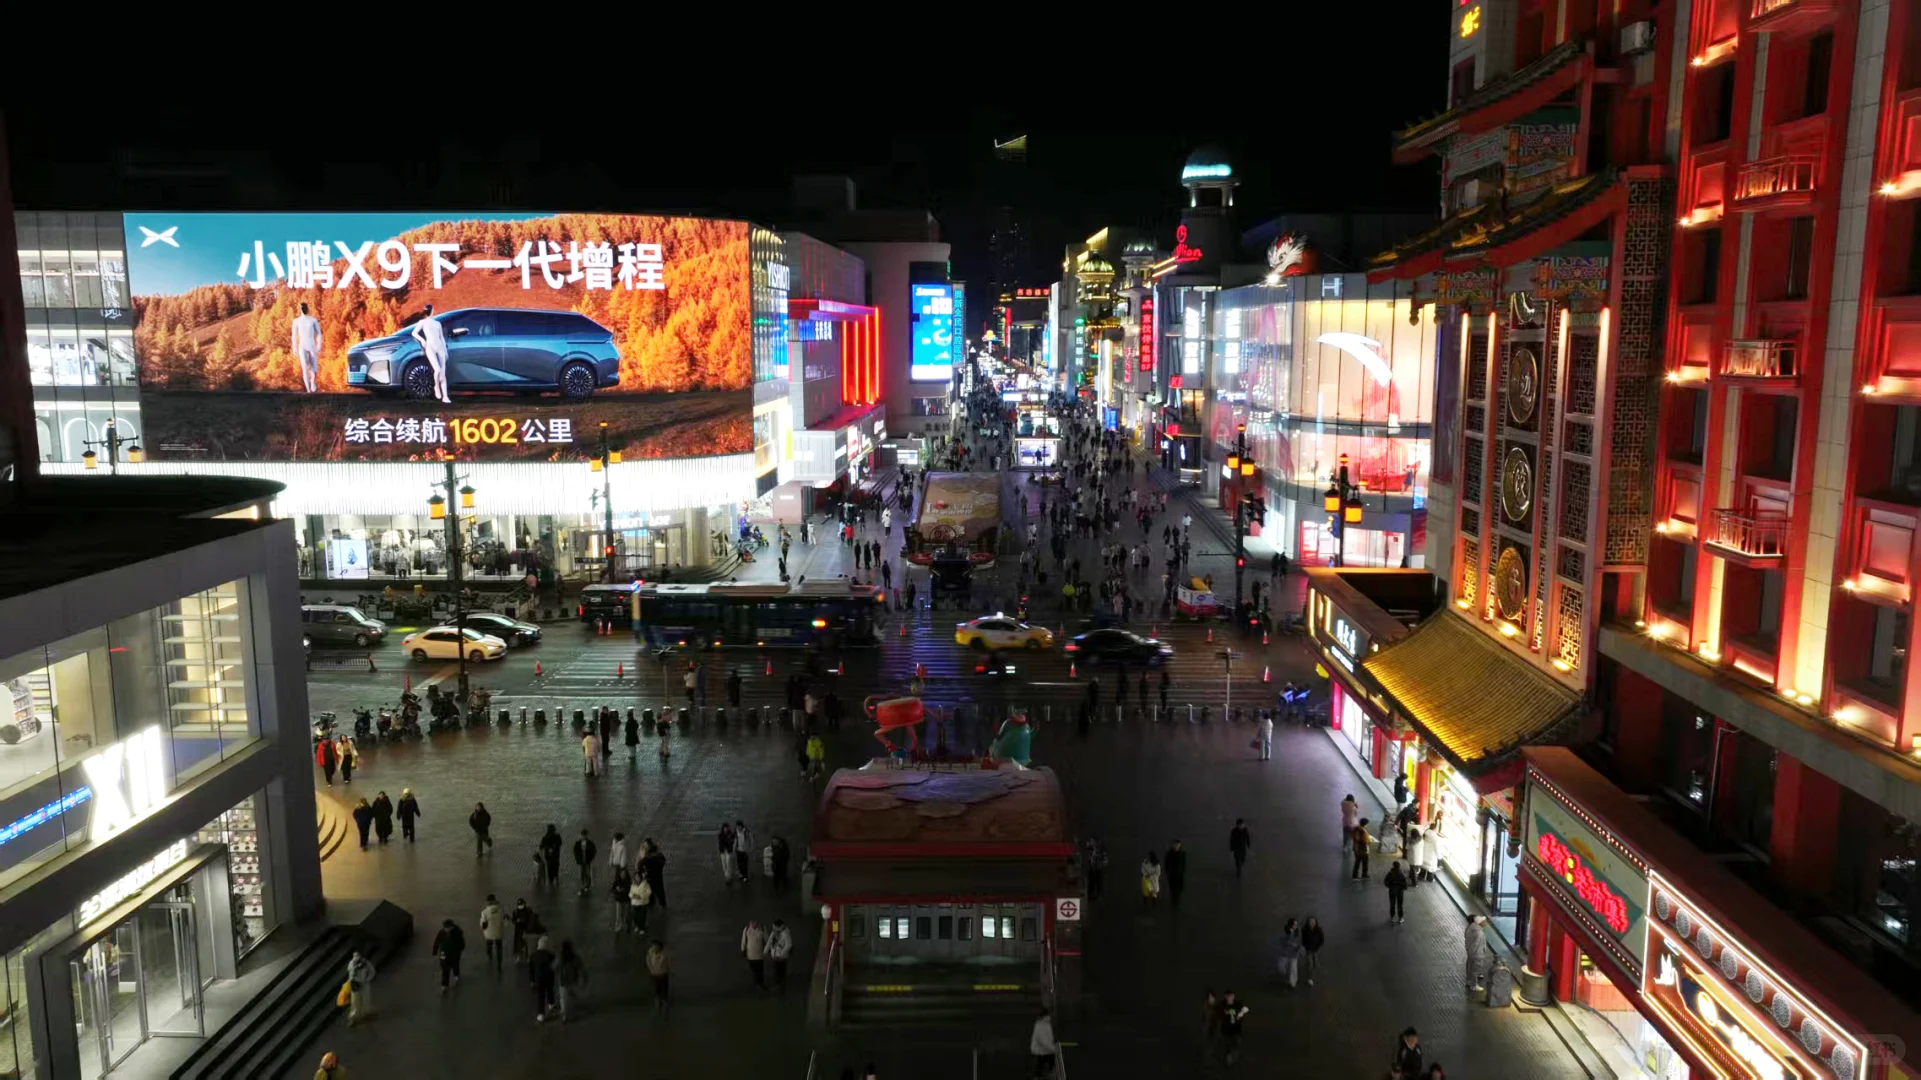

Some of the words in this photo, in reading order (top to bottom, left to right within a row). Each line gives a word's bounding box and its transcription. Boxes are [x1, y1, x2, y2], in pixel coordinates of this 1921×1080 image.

[236, 239, 665, 290] 小鹏X9下一代增程
